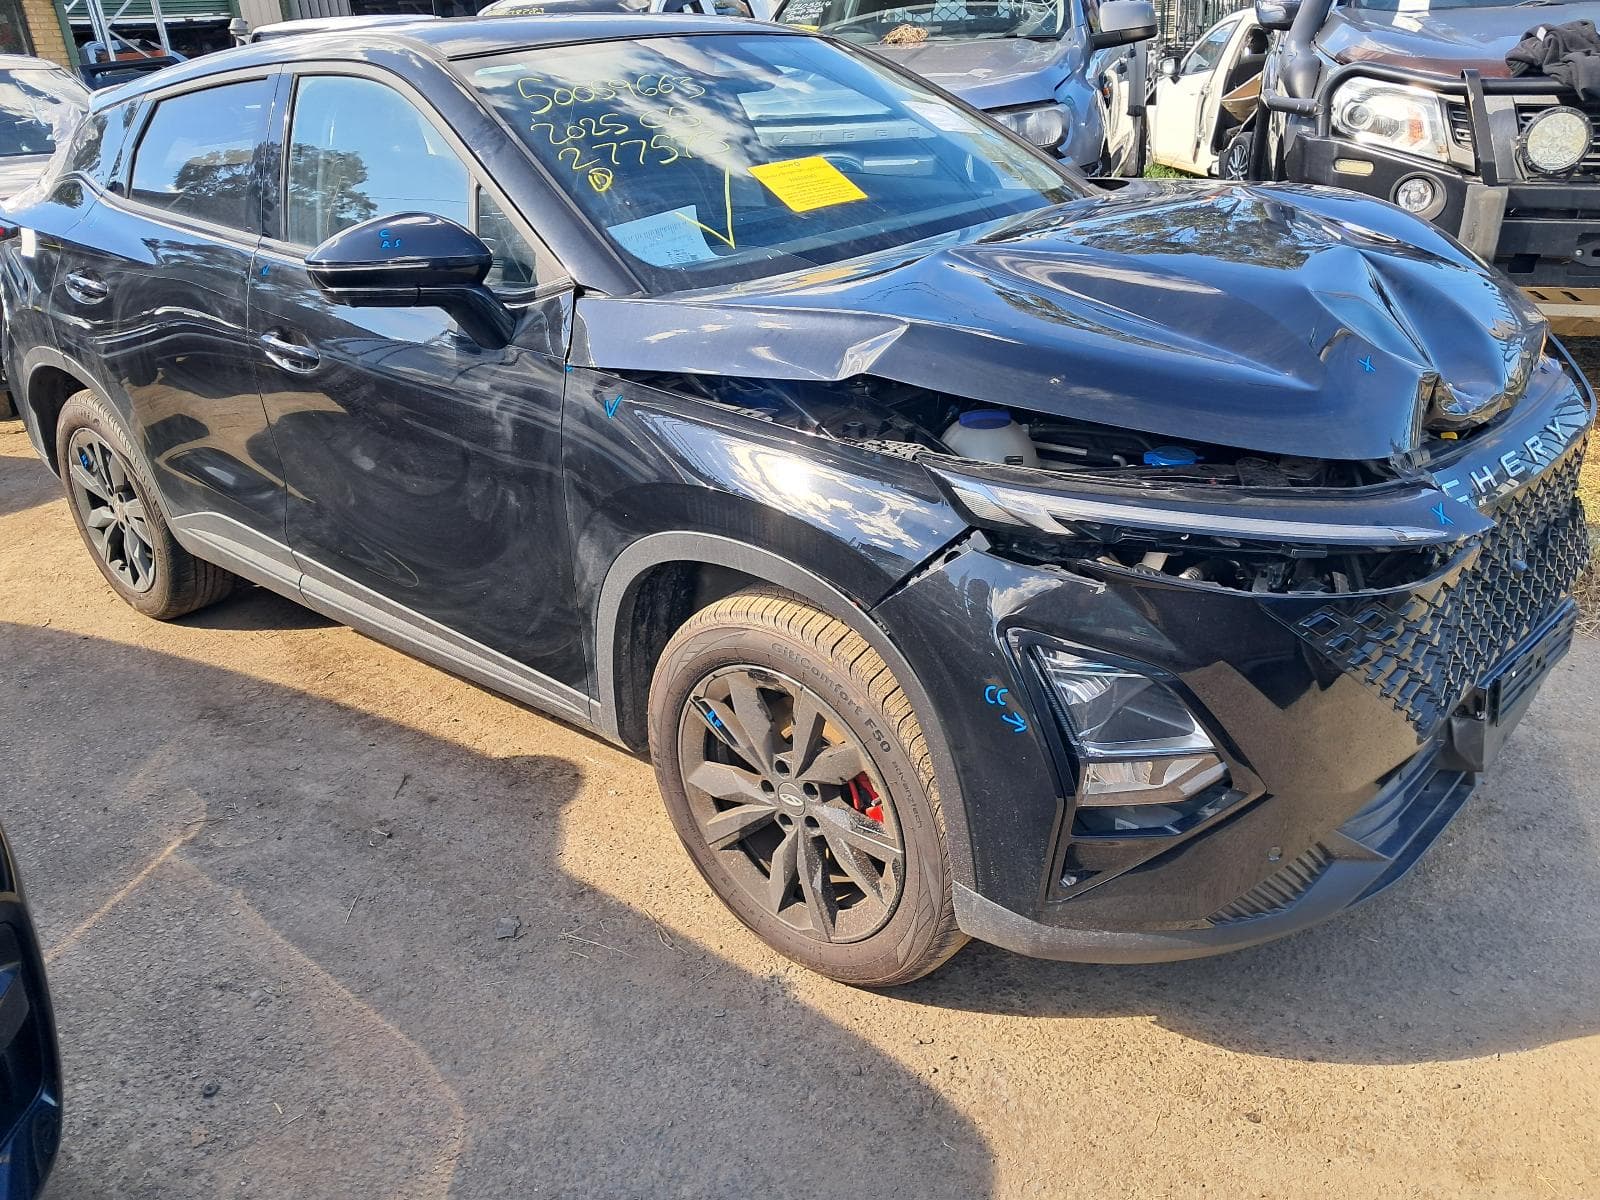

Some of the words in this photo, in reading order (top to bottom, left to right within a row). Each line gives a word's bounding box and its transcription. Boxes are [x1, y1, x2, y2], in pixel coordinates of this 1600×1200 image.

[530, 113, 630, 145] 2025
[1441, 416, 1568, 509] CHERY
[864, 717, 891, 754] F50
